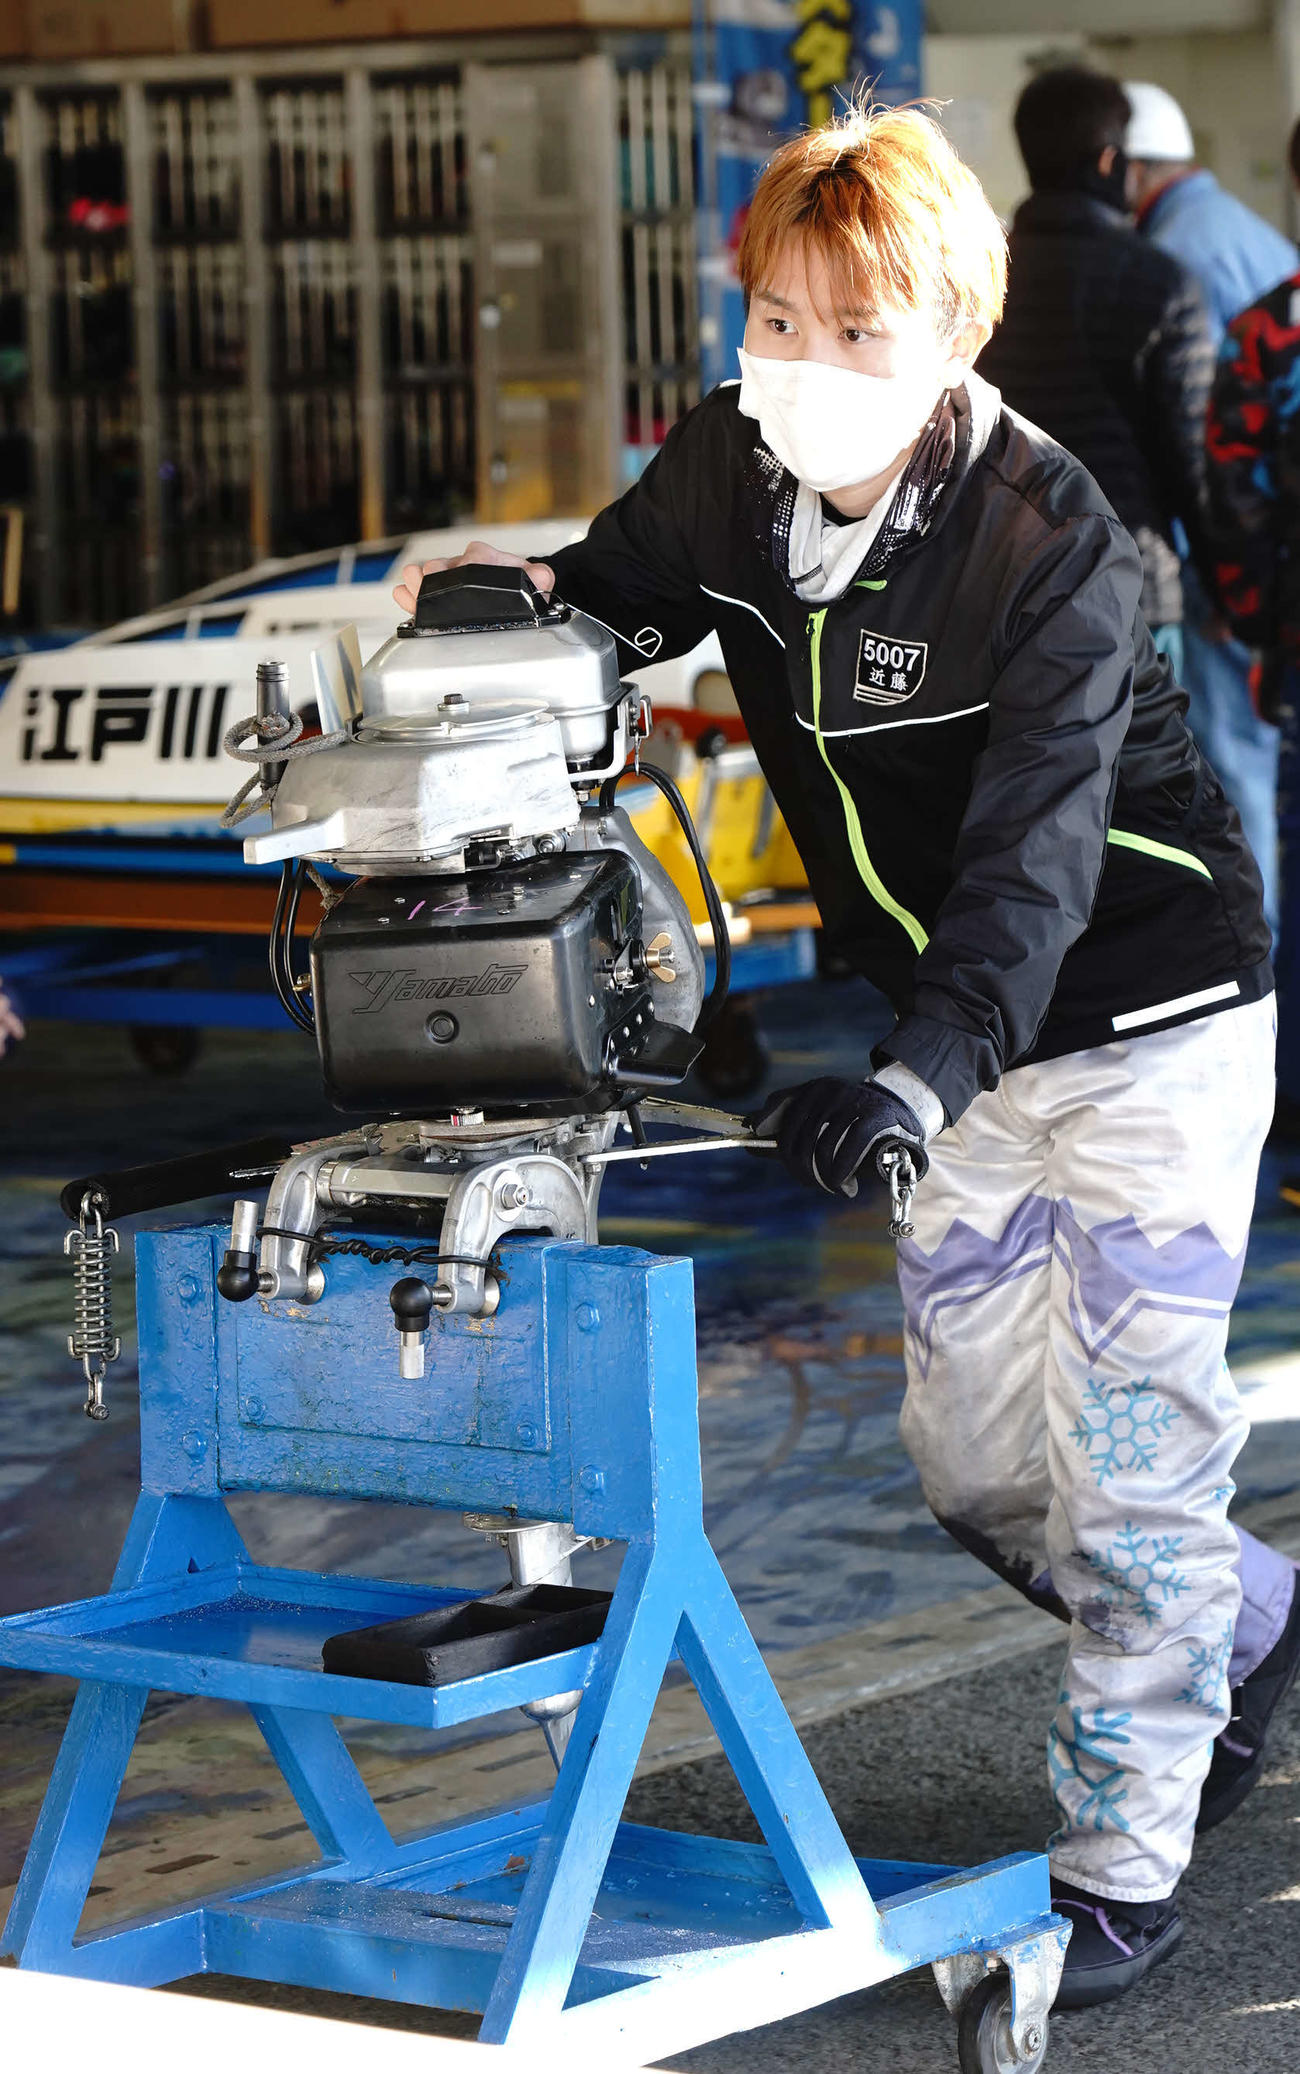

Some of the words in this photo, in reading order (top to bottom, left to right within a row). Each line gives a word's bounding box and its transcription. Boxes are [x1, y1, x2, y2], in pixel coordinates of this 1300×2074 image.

[863, 638, 921, 672] 5007
[868, 667, 909, 691] 近藤
[22, 685, 229, 762] 江戸川
[407, 896, 484, 921] 14
[346, 963, 529, 1015] Yamato
